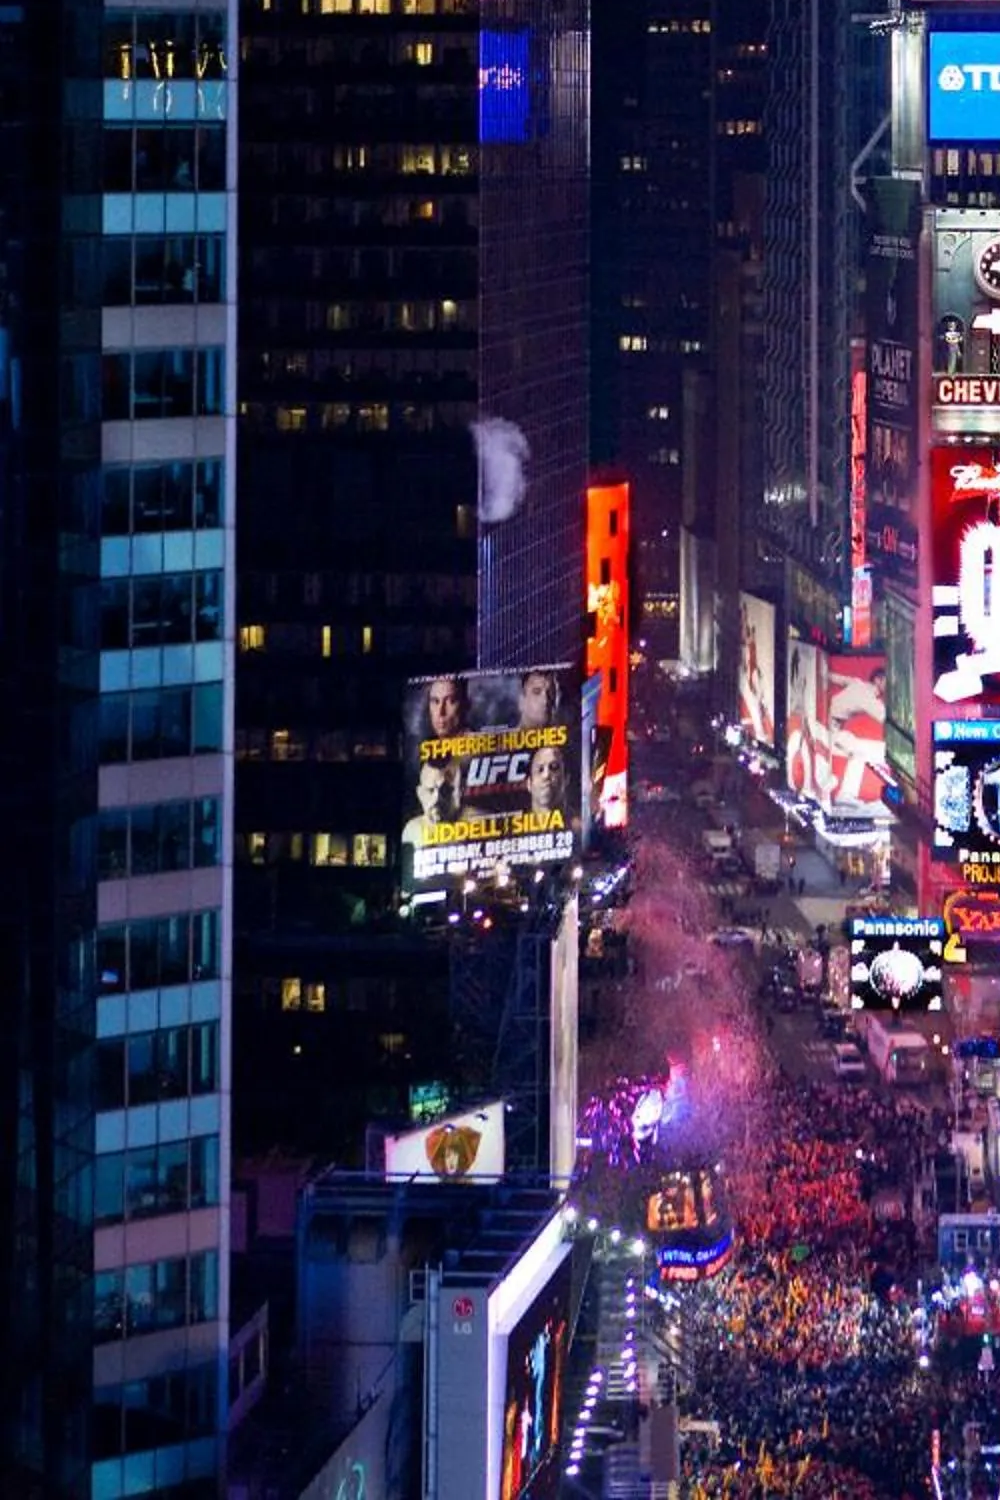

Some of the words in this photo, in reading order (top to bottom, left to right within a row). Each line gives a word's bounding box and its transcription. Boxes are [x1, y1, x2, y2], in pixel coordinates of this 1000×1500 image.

[503, 725, 568, 752] HUGHES
[466, 752, 531, 787] UFC
[423, 819, 502, 846] LIDDELL
[511, 809, 565, 834] SILVA
[853, 918, 939, 936] Panasonic
